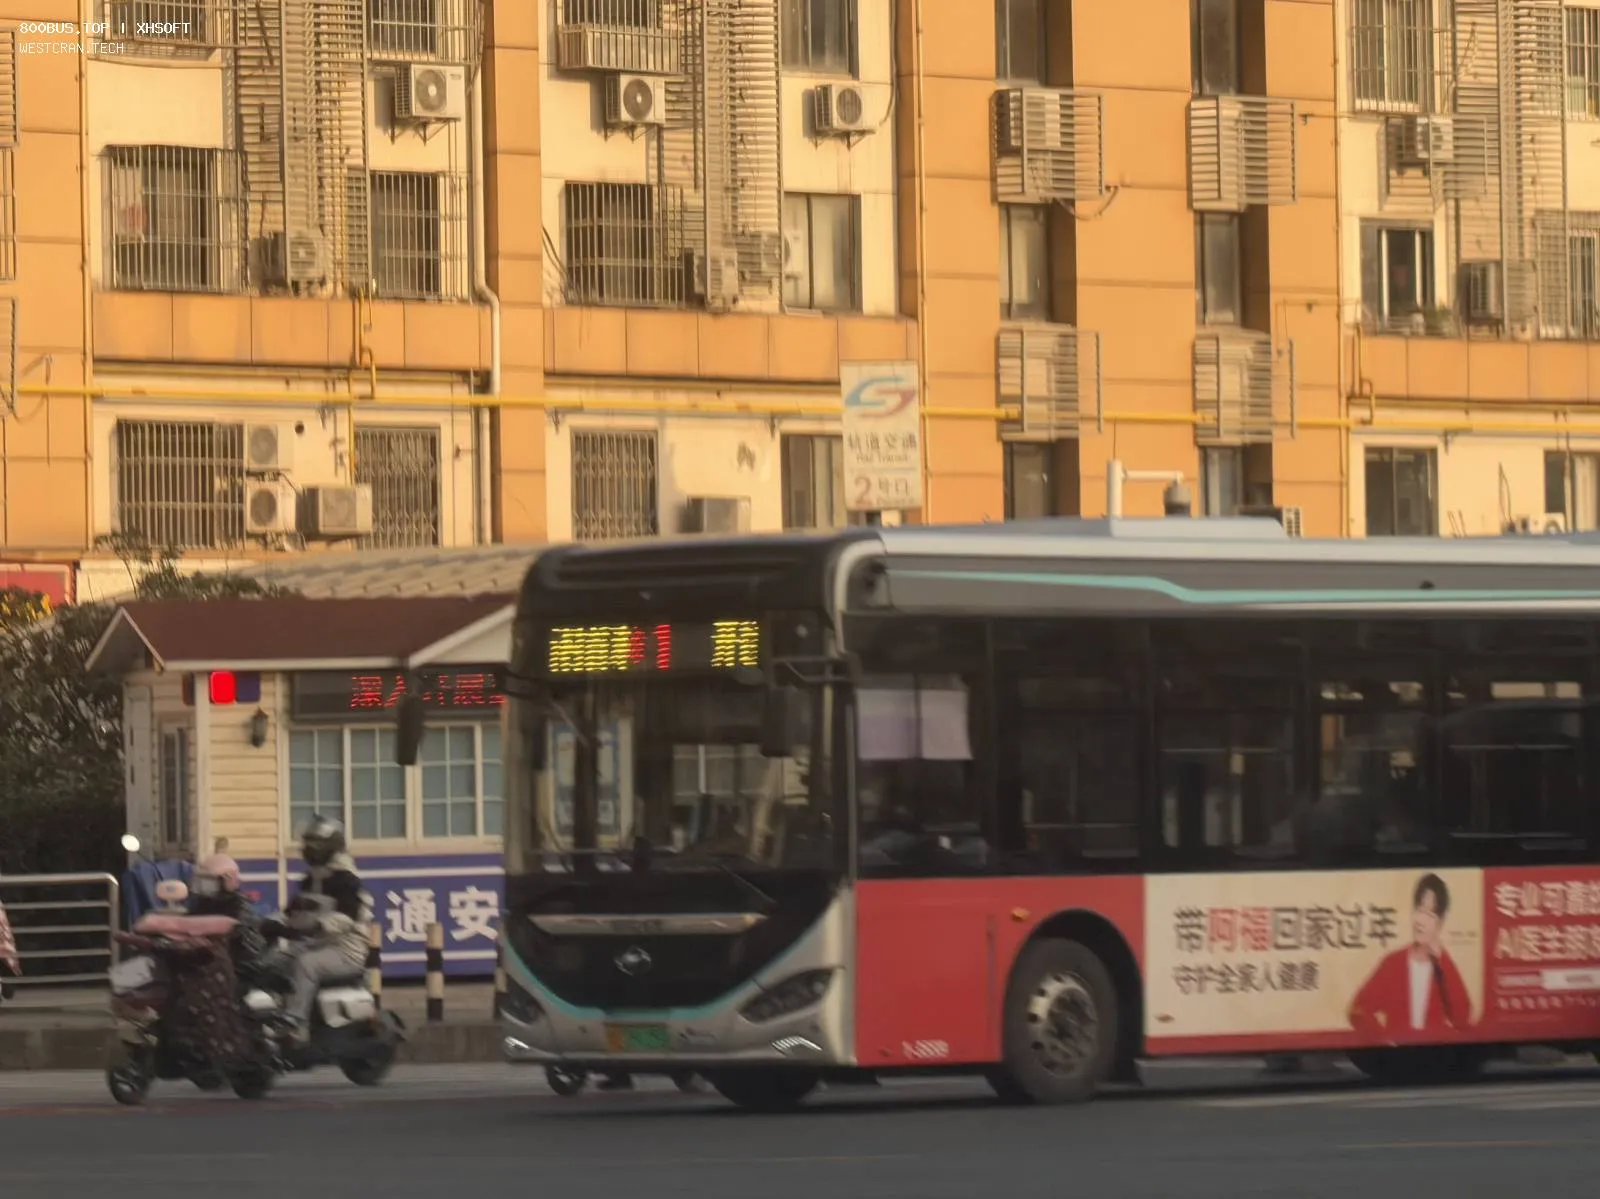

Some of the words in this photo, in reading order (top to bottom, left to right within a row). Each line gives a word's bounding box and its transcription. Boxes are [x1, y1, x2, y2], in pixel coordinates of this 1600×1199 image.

[360, 886, 499, 943] 通安
[1174, 904, 1398, 953] 带阿福回家过年
